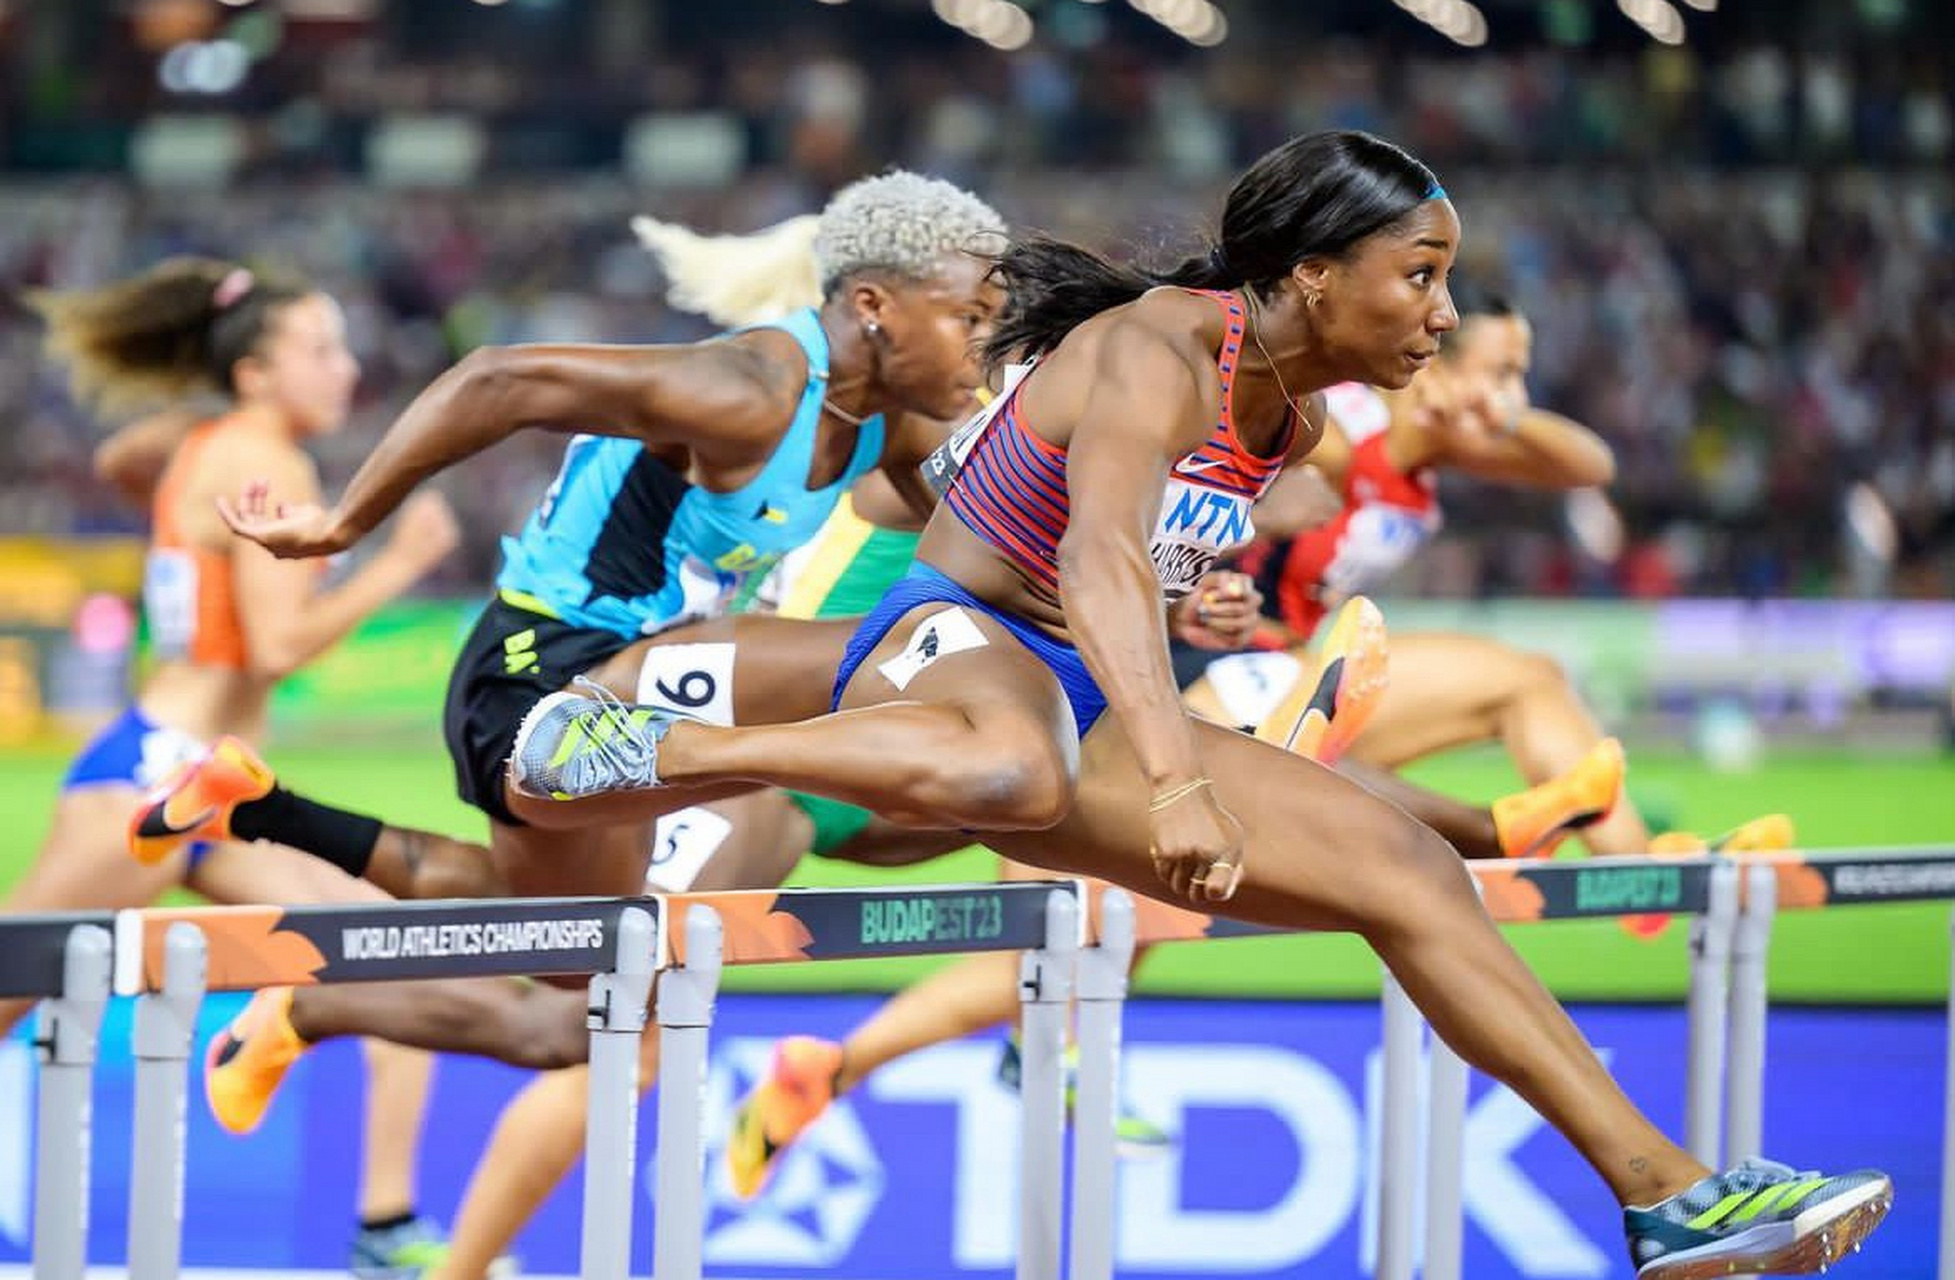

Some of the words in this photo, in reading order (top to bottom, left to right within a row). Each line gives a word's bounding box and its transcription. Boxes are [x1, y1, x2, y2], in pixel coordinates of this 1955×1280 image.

[1164, 489, 1251, 546] NTN
[341, 927, 402, 960] WORLD
[400, 923, 483, 957] ATHLETICS
[482, 919, 604, 954] CHAMPIONSHIPS
